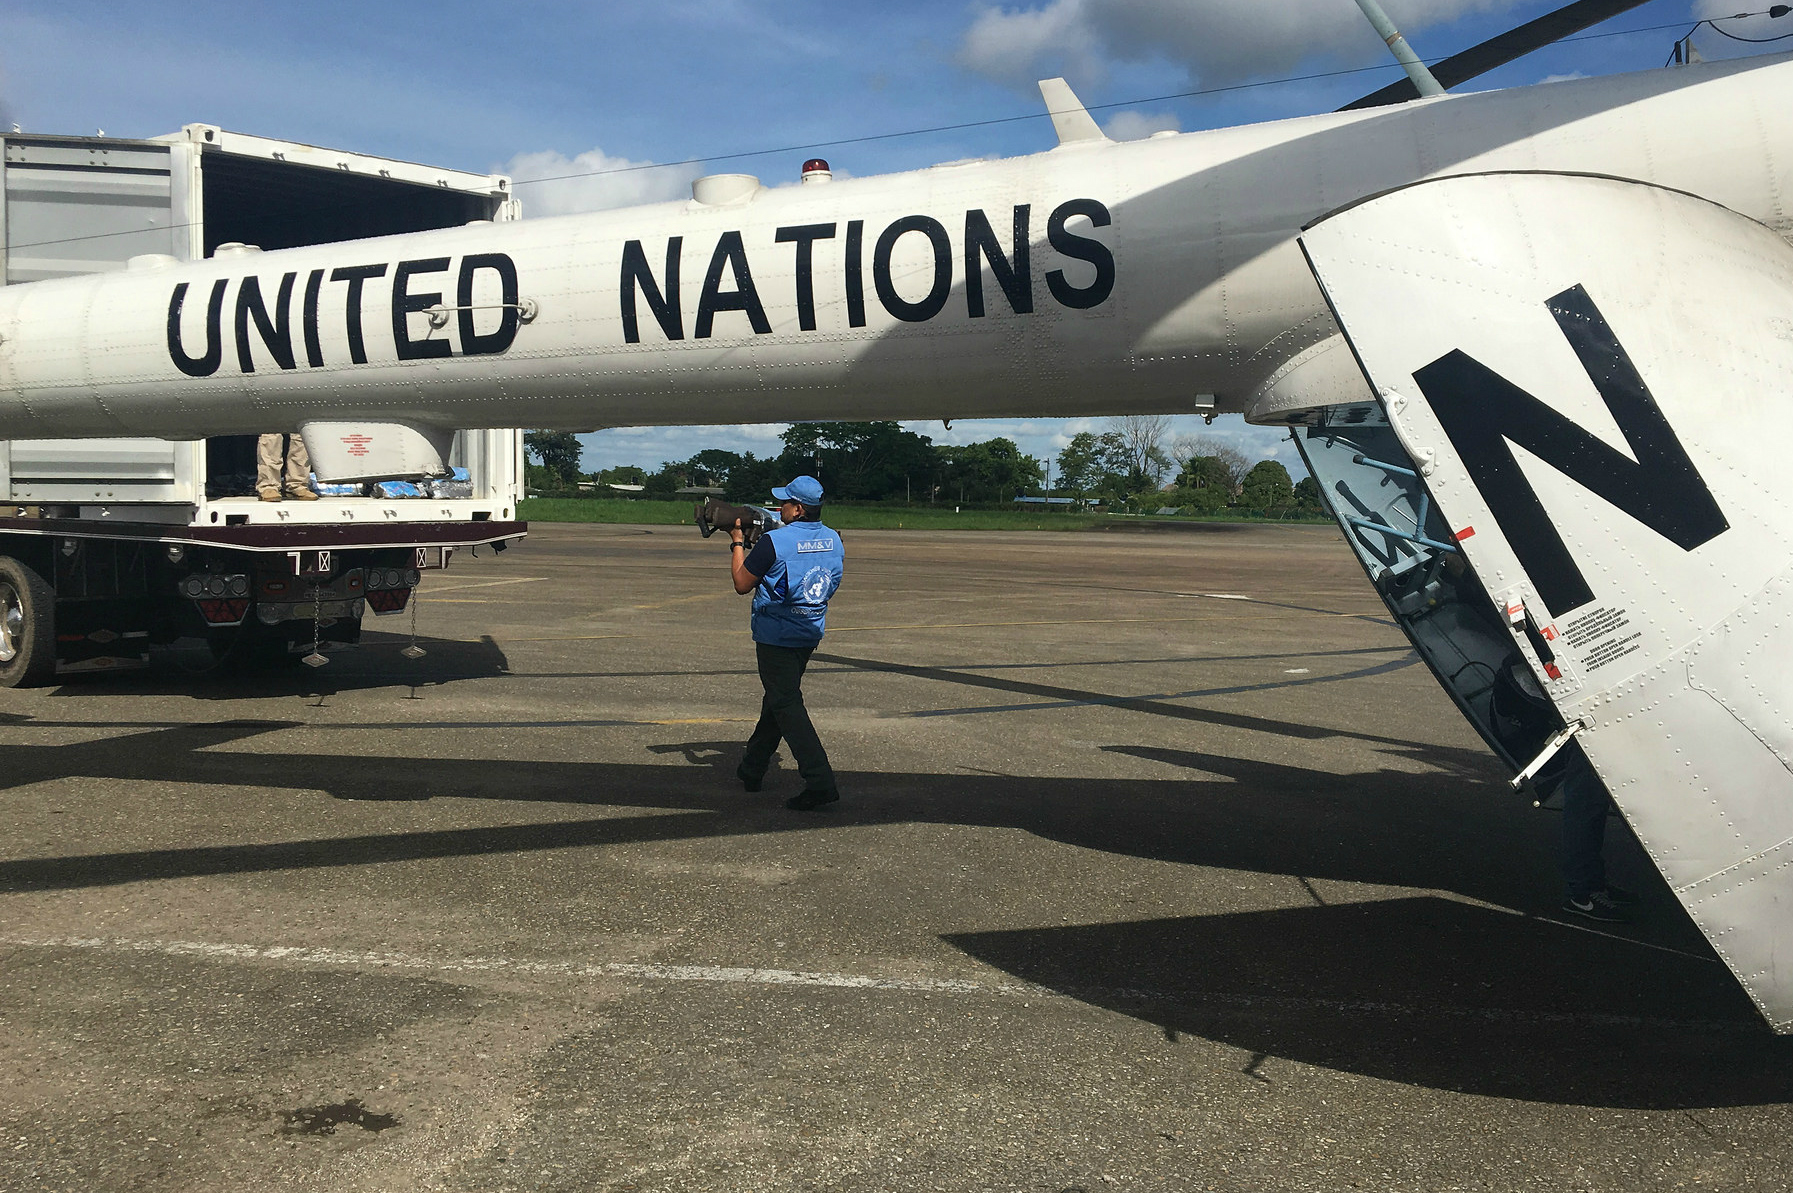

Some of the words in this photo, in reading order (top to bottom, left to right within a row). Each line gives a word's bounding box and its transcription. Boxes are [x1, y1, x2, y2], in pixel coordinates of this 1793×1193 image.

[168, 253, 518, 377] UNITED
[620, 198, 1116, 344] NATIONS
[1412, 283, 1730, 618] N
